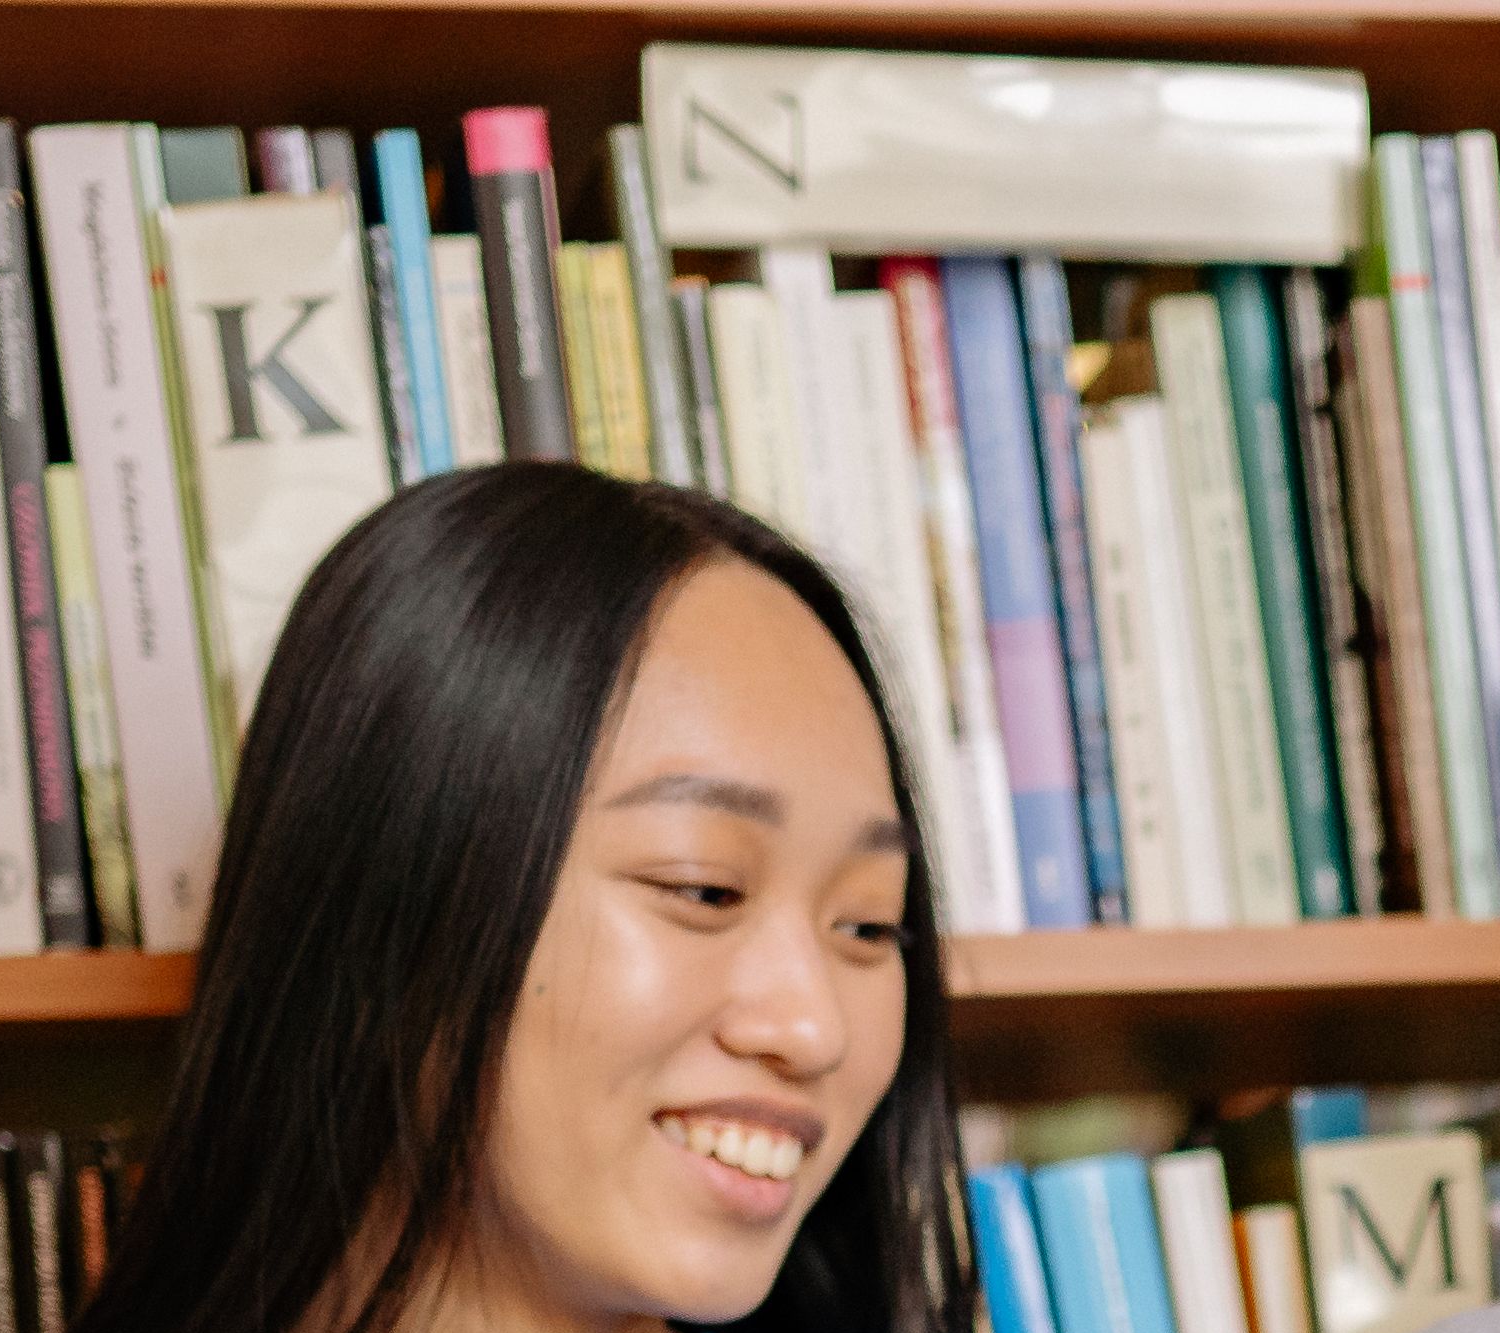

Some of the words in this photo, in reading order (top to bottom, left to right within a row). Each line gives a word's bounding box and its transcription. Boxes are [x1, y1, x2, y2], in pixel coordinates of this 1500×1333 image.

[682, 91, 803, 191] N
[197, 299, 360, 444] K
[1335, 1176, 1463, 1288] M
